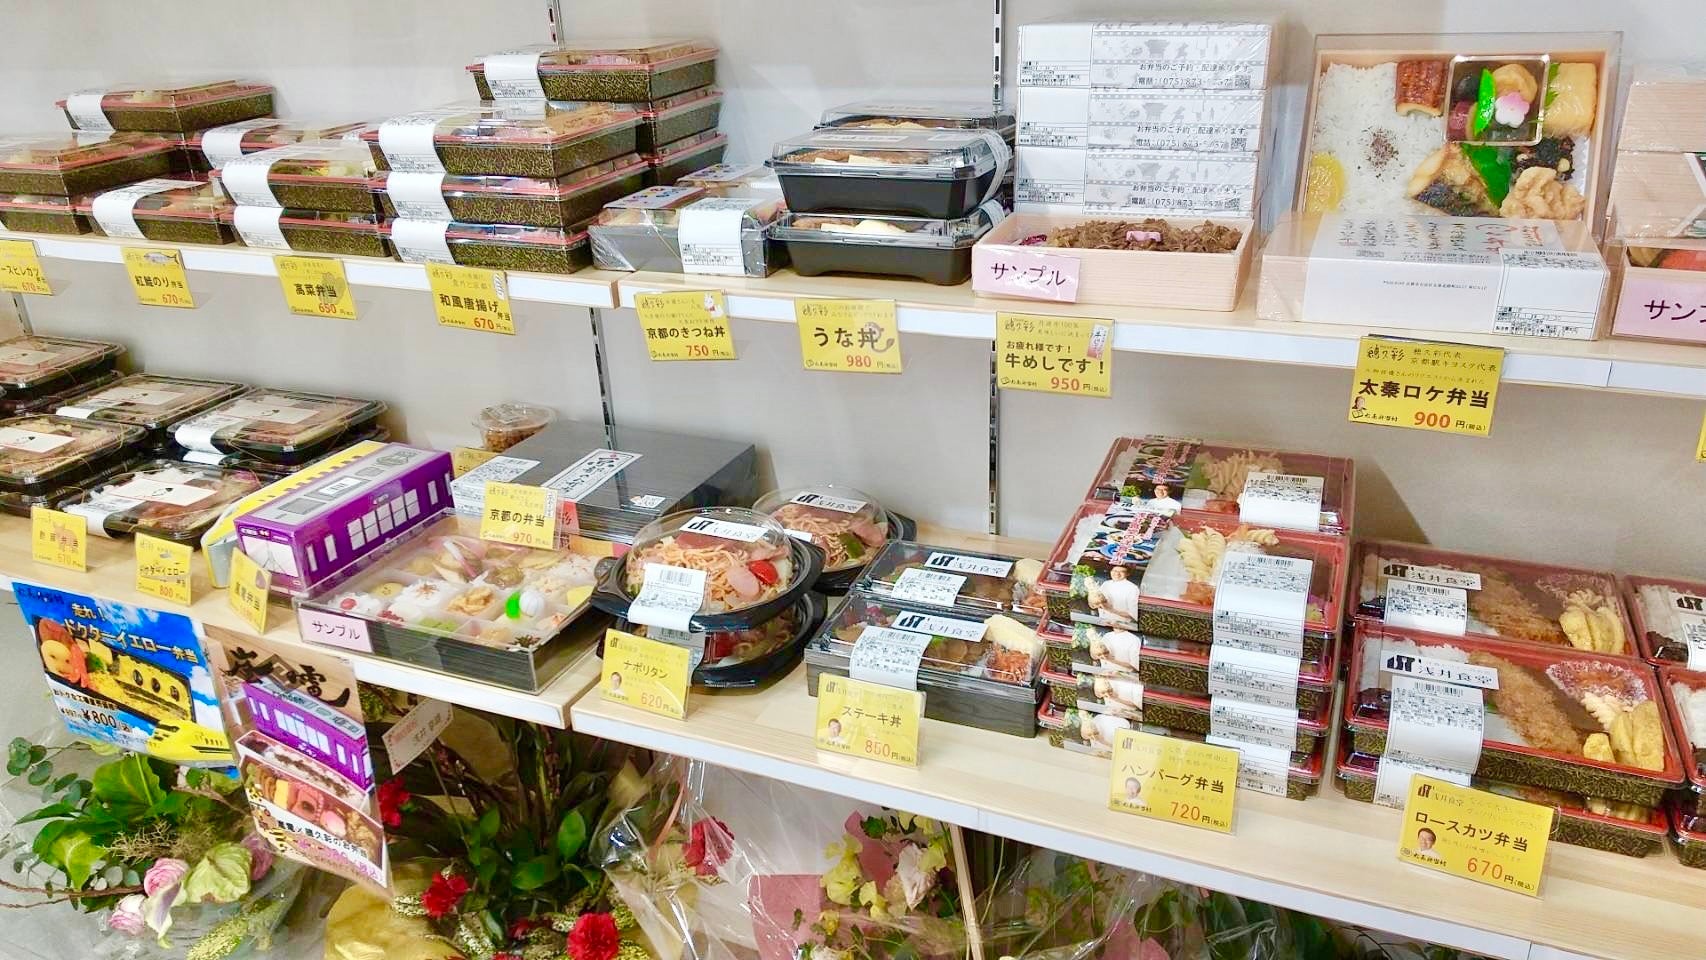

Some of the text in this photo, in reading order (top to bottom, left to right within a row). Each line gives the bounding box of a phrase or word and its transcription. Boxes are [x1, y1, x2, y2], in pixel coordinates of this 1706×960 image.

[991, 262, 1066, 287] サンプル
[162, 294, 179, 304] 670
[294, 283, 337, 297] 高菜弁当
[1644, 300, 1706, 322] サン
[474, 317, 495, 329] 670
[646, 325, 726, 339] 京都のきつね丼
[814, 327, 878, 349] うな丼
[1006, 341, 1071, 353] お疲れ様です！
[686, 345, 709, 357] 750
[846, 355, 872, 367] 980
[1005, 353, 1104, 374] 牛めしです！
[1050, 376, 1080, 391] 950
[1358, 378, 1490, 408] 太秦ロケ弁当
[1414, 411, 1450, 428] 900
[489, 508, 545, 527] 京都の弁当
[513, 533, 532, 544] 970
[71, 603, 107, 621] 走れ！
[64, 618, 199, 664] ドクターイエロー弁当
[624, 660, 668, 679] ナポリタン
[641, 692, 663, 709] 620
[843, 705, 902, 729] ステーキ丼
[865, 740, 890, 758] 850
[1121, 763, 1225, 794] ハンバーグ弁当
[1170, 802, 1200, 822] 720
[1415, 811, 1528, 853] ロースカツ弁当
[1467, 857, 1503, 880] 670
